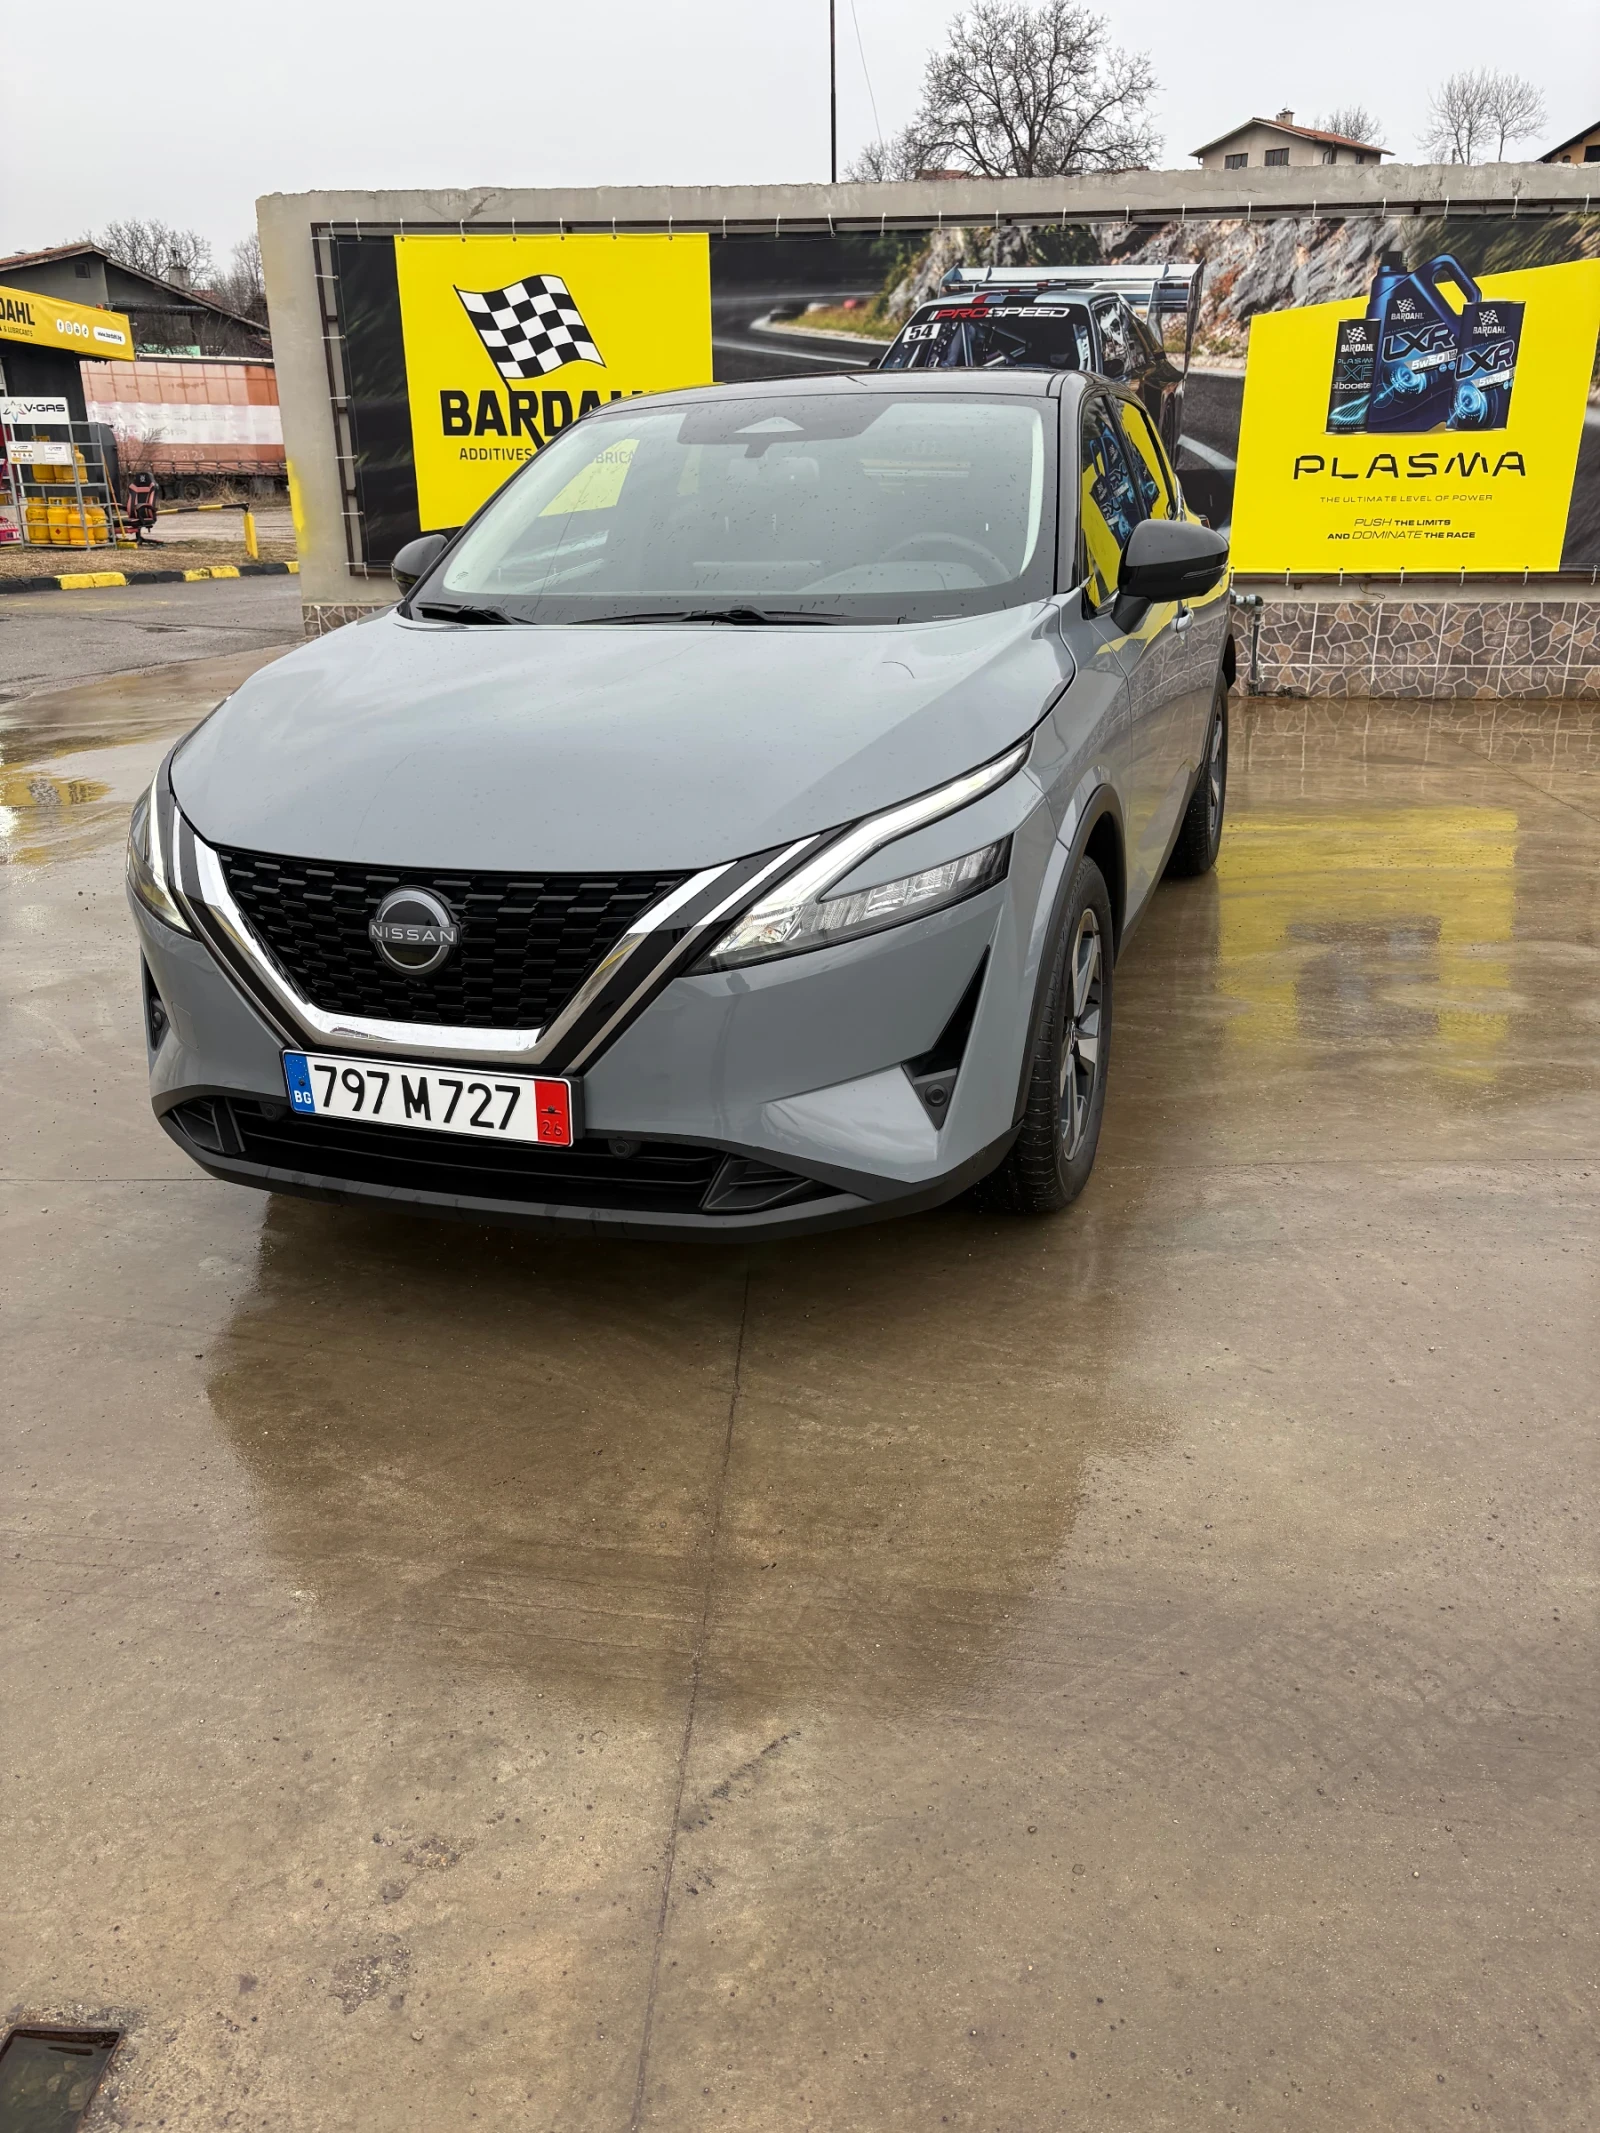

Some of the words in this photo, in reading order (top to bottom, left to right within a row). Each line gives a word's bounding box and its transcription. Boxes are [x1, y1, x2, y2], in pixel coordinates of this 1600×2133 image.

[908, 324, 934, 341] 54
[1341, 343, 1374, 355] BARDAHL
[1382, 322, 1456, 363] LXR
[1454, 339, 1516, 381] LXR
[459, 447, 532, 461] ADDITIVES
[1293, 451, 1526, 480] PLASMA
[1343, 495, 1397, 503] ULTIMATE
[1435, 494, 1450, 502] OF
[1354, 517, 1393, 527] PUSH
[1352, 530, 1423, 540] DOMINATE
[1446, 531, 1476, 539] RACE
[370, 924, 454, 943] NISSAN
[294, 1090, 312, 1105] BG
[314, 1064, 390, 1114] 797
[401, 1073, 432, 1121] M
[438, 1078, 521, 1130] 727
